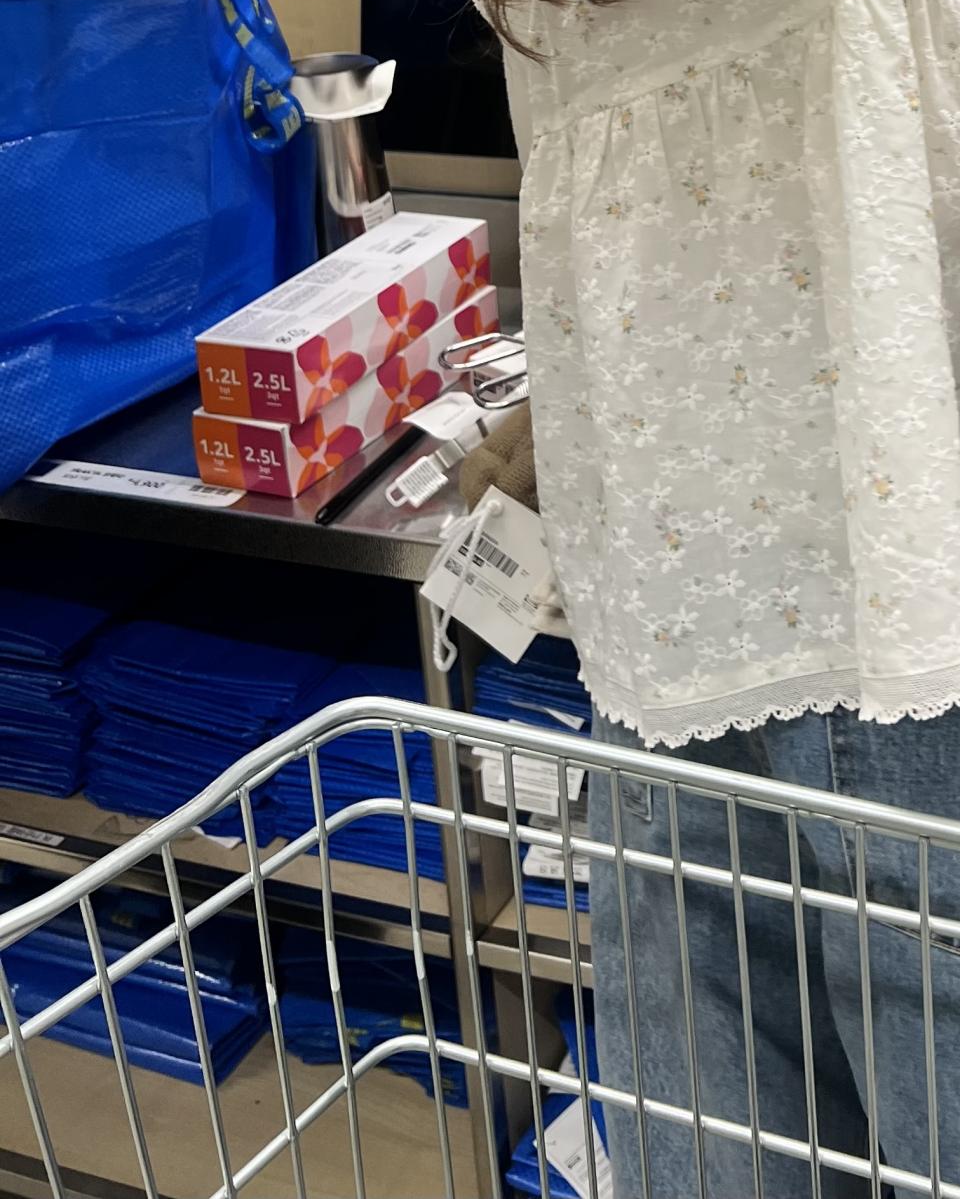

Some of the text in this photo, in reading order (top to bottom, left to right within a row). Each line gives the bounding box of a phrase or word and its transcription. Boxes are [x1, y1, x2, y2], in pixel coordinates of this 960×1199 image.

[205, 366, 242, 386] 1.2L
[252, 372, 291, 392] 2.5L
[200, 439, 235, 459] 1.2L
[244, 446, 282, 467] 2.5L
